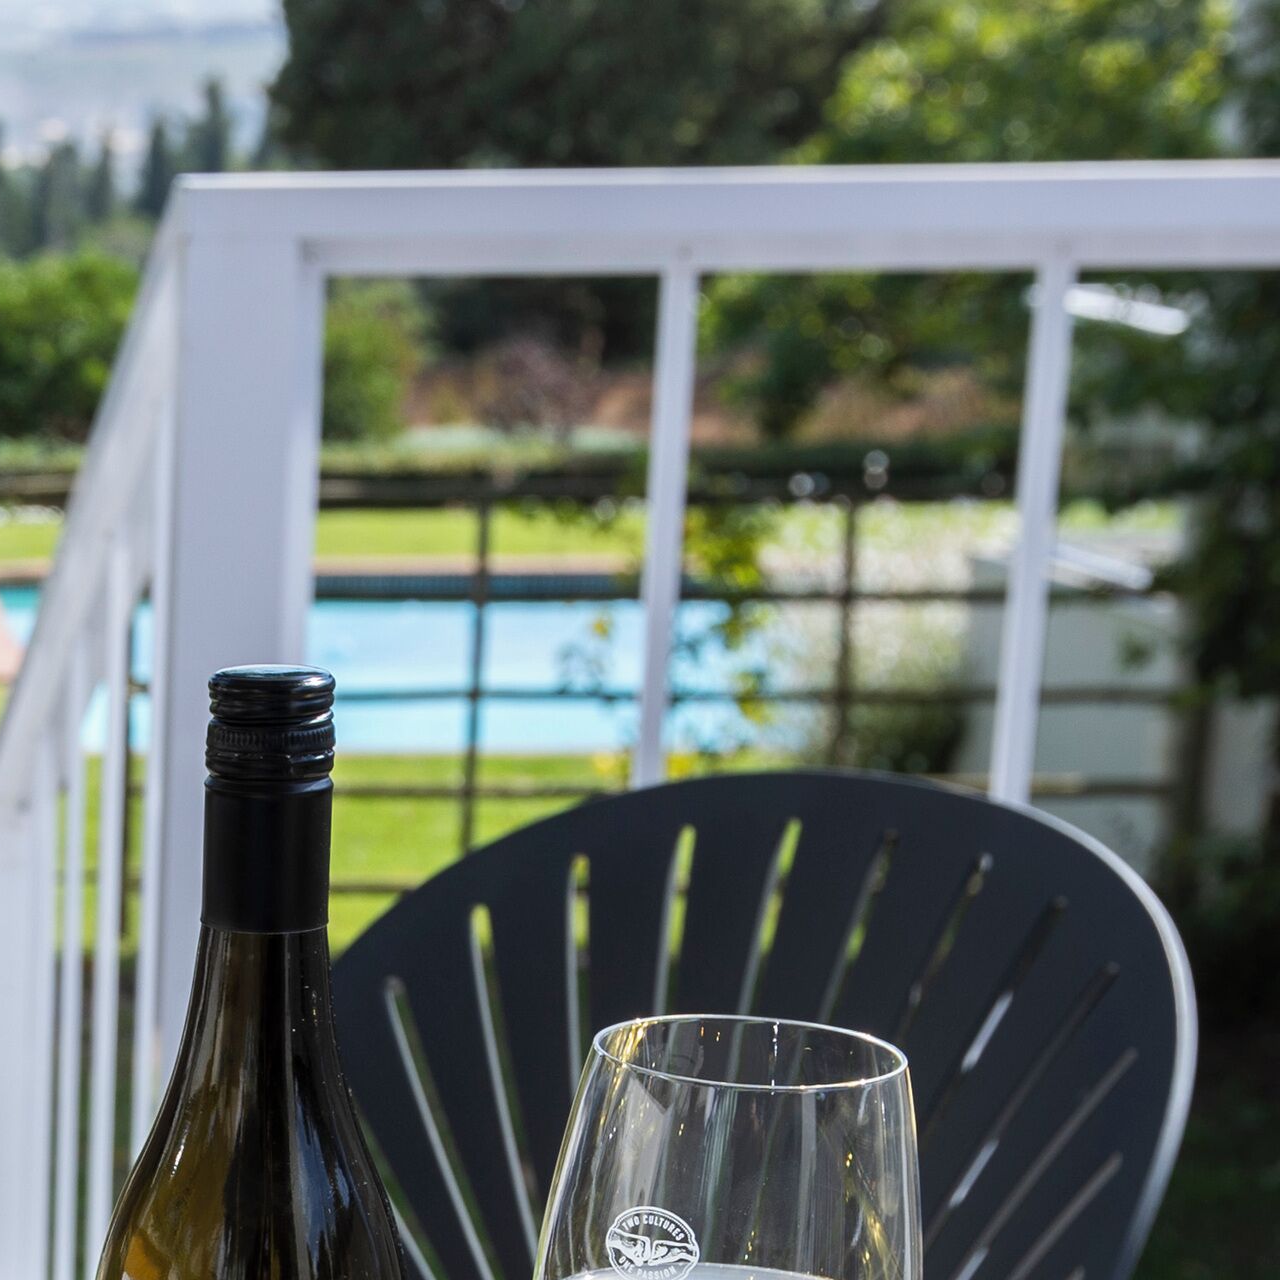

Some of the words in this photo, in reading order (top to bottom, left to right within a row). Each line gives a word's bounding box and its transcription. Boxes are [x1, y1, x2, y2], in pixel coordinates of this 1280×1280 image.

[622, 1216, 640, 1231] TWO
[642, 1215, 685, 1241] CULTURES
[618, 1256, 634, 1273] ONE
[637, 1265, 677, 1280] PASSION
